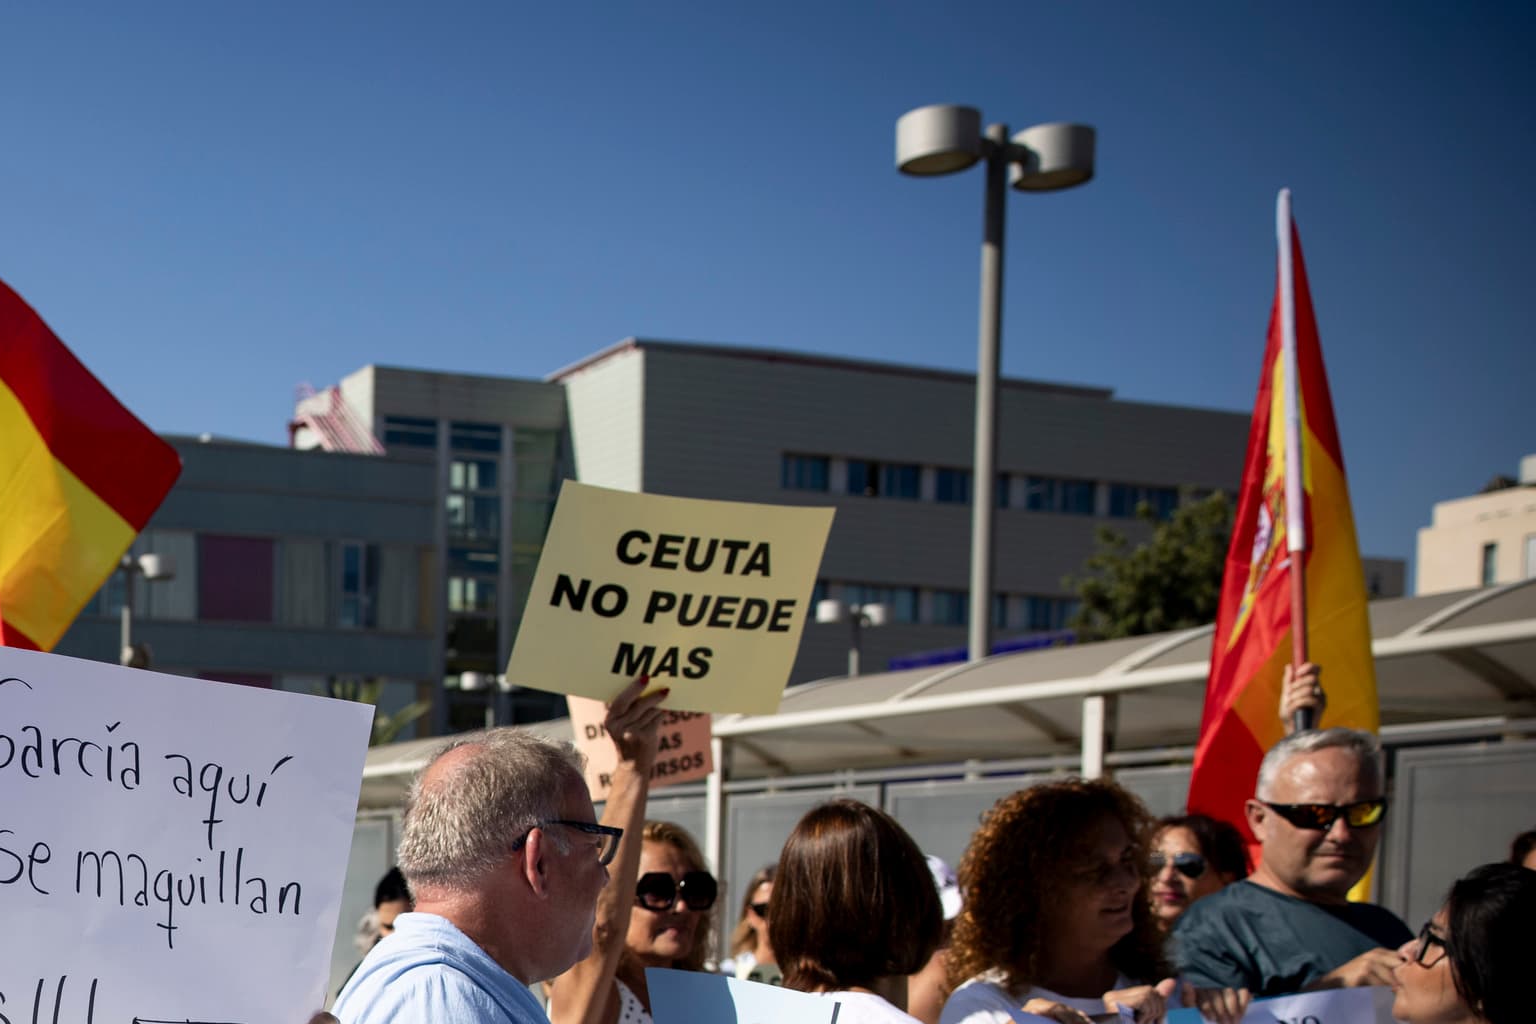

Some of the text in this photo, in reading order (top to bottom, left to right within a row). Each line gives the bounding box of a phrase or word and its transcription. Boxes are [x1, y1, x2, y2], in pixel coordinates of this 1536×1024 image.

[615, 529, 771, 577] CEUTA
[549, 573, 797, 633] NO PUEDE
[611, 642, 713, 680] MAS
[163, 755, 294, 850] aquí
[76, 848, 302, 950] maquillan
